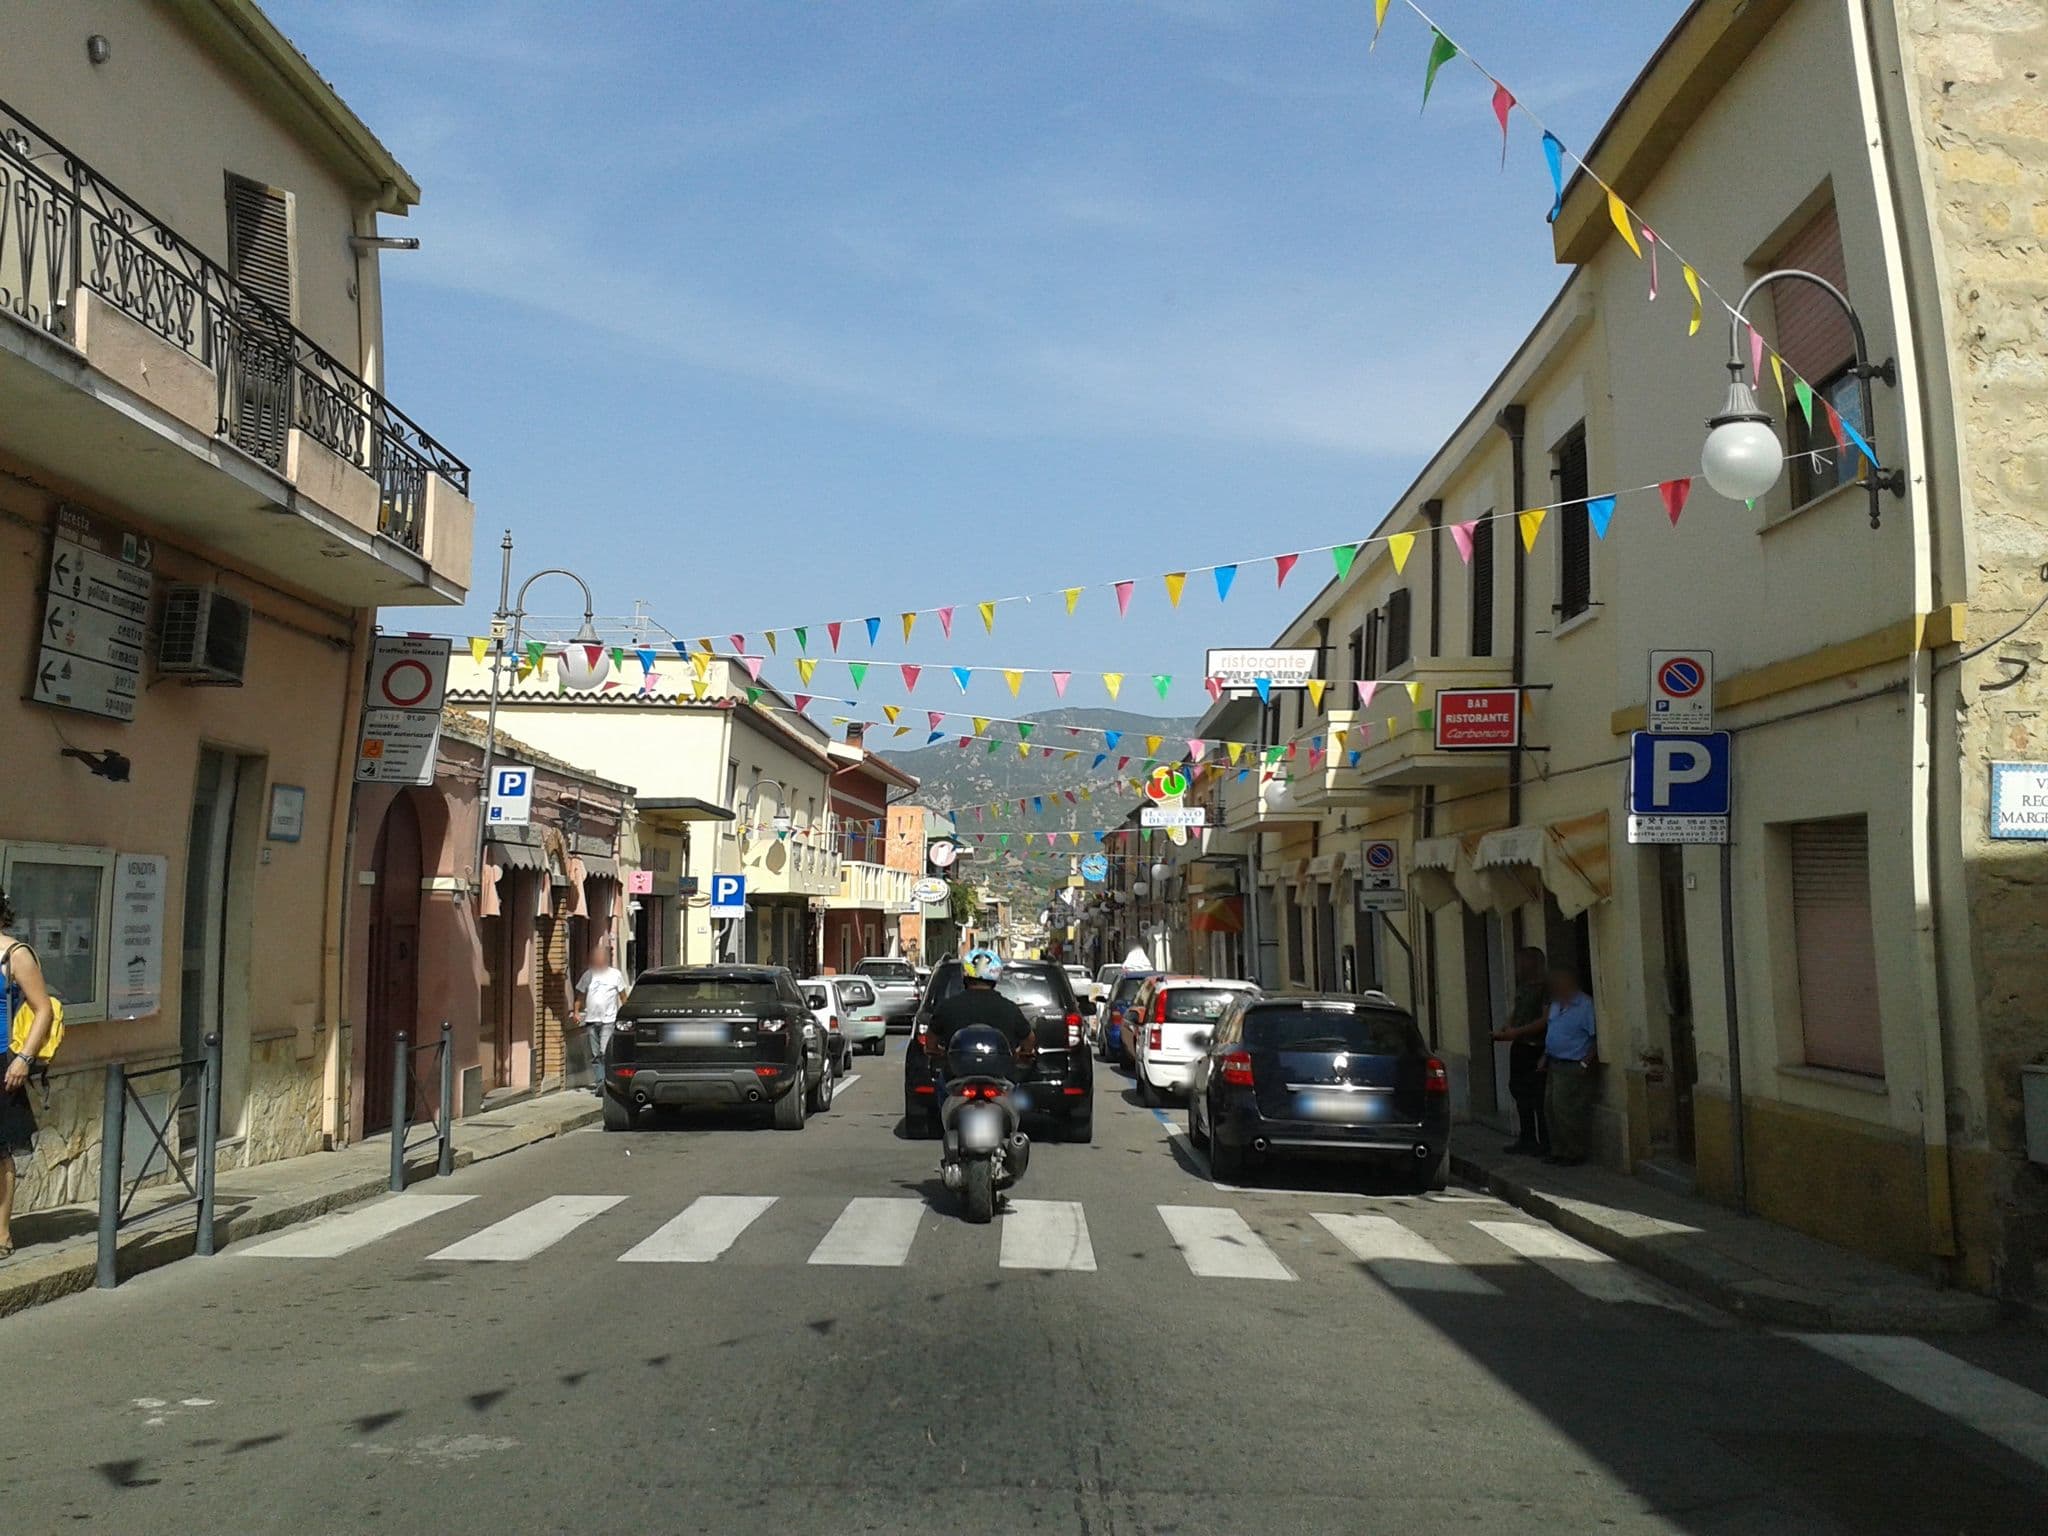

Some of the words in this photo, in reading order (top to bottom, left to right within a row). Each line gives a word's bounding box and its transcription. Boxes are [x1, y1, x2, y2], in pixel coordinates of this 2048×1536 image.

[117, 624, 143, 641] centro
[379, 646, 410, 656] traffico
[1220, 654, 1307, 669] ristorante
[1467, 699, 1488, 708] BAR
[1446, 712, 1509, 724] RISTORANTE
[1446, 727, 1510, 739] Carbonara
[1653, 740, 1712, 807] P
[503, 773, 522, 795] P
[2036, 777, 2048, 790] V
[128, 862, 157, 876] VENDITA
[718, 877, 739, 904] P
